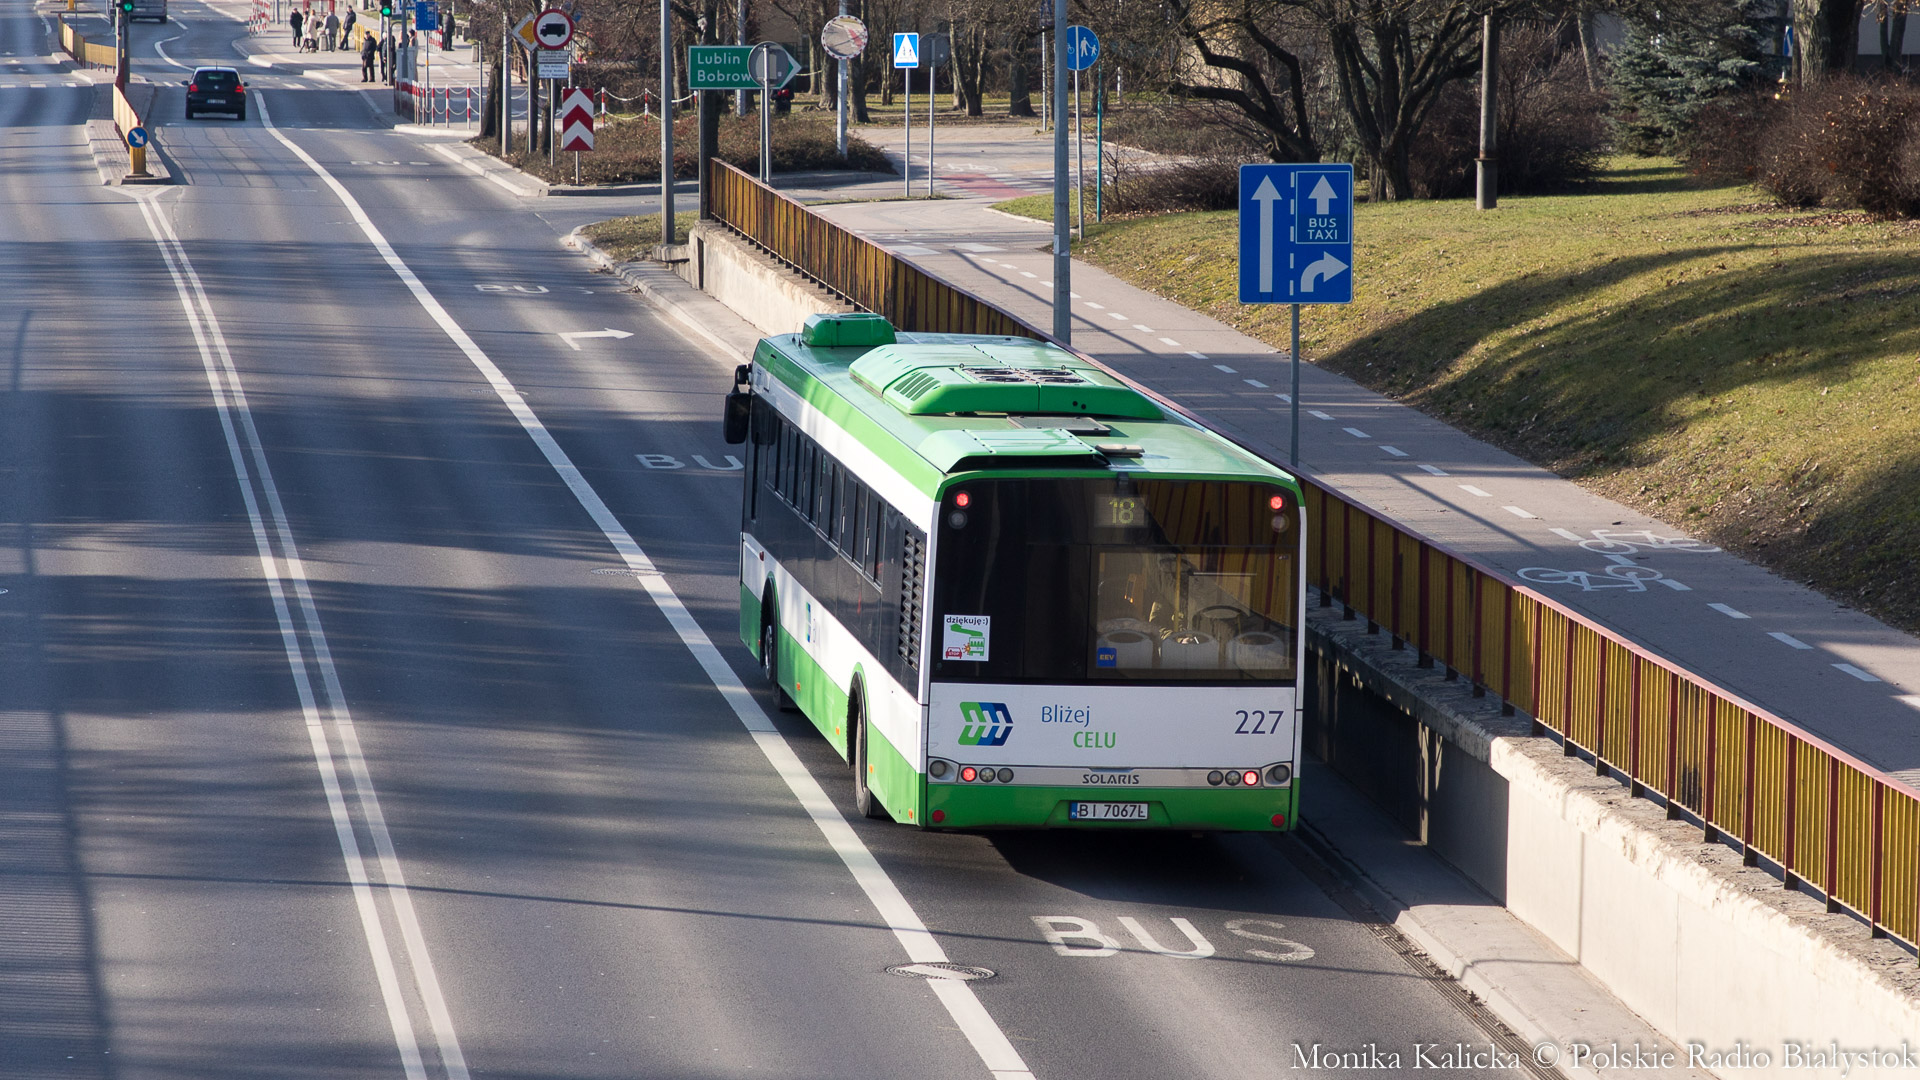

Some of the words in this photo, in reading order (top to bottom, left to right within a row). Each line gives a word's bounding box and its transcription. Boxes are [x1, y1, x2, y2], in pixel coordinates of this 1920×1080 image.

[697, 52, 741, 65] Lublin
[1308, 217, 1337, 228] BUS
[1307, 229, 1338, 240] TAXI
[1109, 497, 1135, 524] 18
[1041, 704, 1090, 728] Bliżej
[1234, 709, 1285, 735] 227
[1073, 730, 1116, 749] CELU
[1082, 774, 1140, 785] SOLARIS
[1079, 804, 1097, 818] BI
[1103, 804, 1146, 818] 7067L
[1029, 915, 1316, 962] BUS
